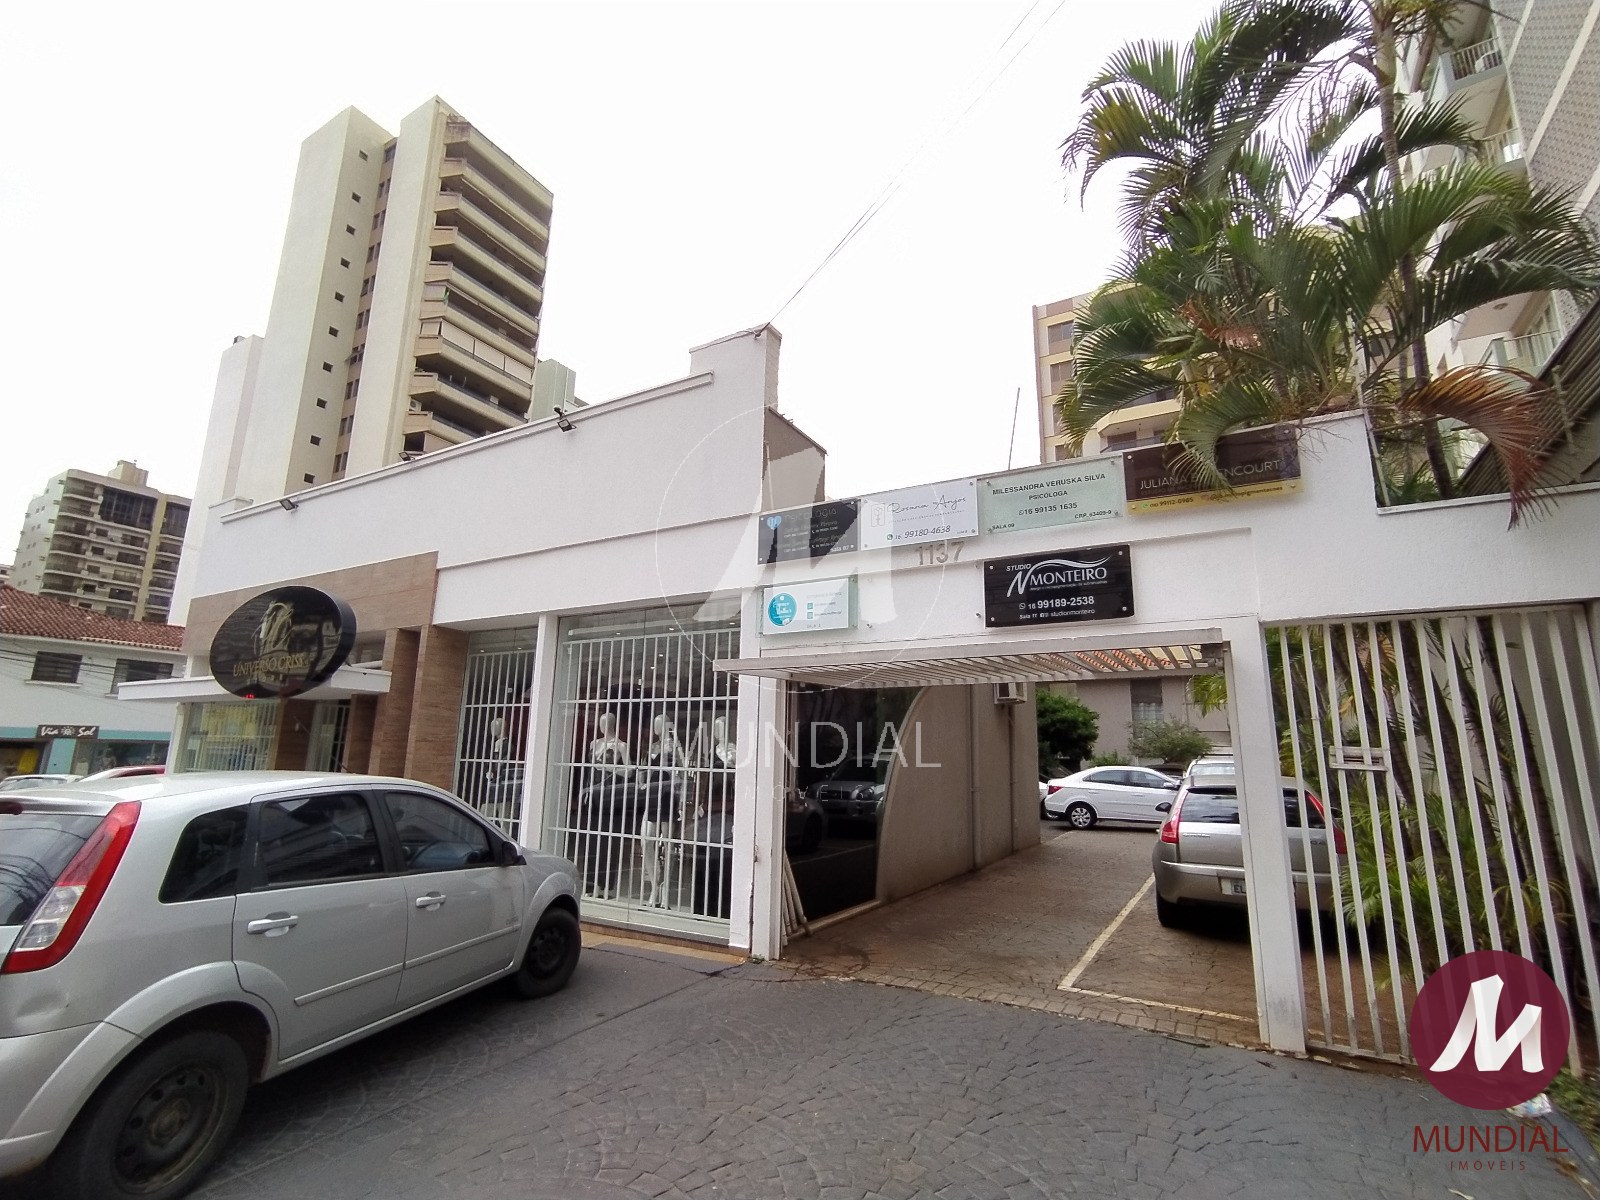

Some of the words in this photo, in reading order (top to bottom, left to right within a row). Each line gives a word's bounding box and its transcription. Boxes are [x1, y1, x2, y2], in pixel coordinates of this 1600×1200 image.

[992, 483, 1044, 495] MILESSANDRA
[1046, 477, 1082, 488] VERUSKA
[1084, 473, 1106, 482] SILVA
[1140, 474, 1187, 489] JULIANA
[887, 502, 929, 513] Rosana
[933, 494, 966, 510] Anjos
[1035, 505, 1057, 514] 99135
[1060, 502, 1078, 511] 1635
[904, 525, 951, 539] 99180-4638
[914, 541, 965, 566] 1137
[1006, 563, 1032, 572] STUDIO
[1030, 567, 1107, 586] MONTEIRO
[1037, 595, 1095, 609] 99189-2538
[41, 726, 59, 736] Via
[77, 726, 96, 737] Sol
